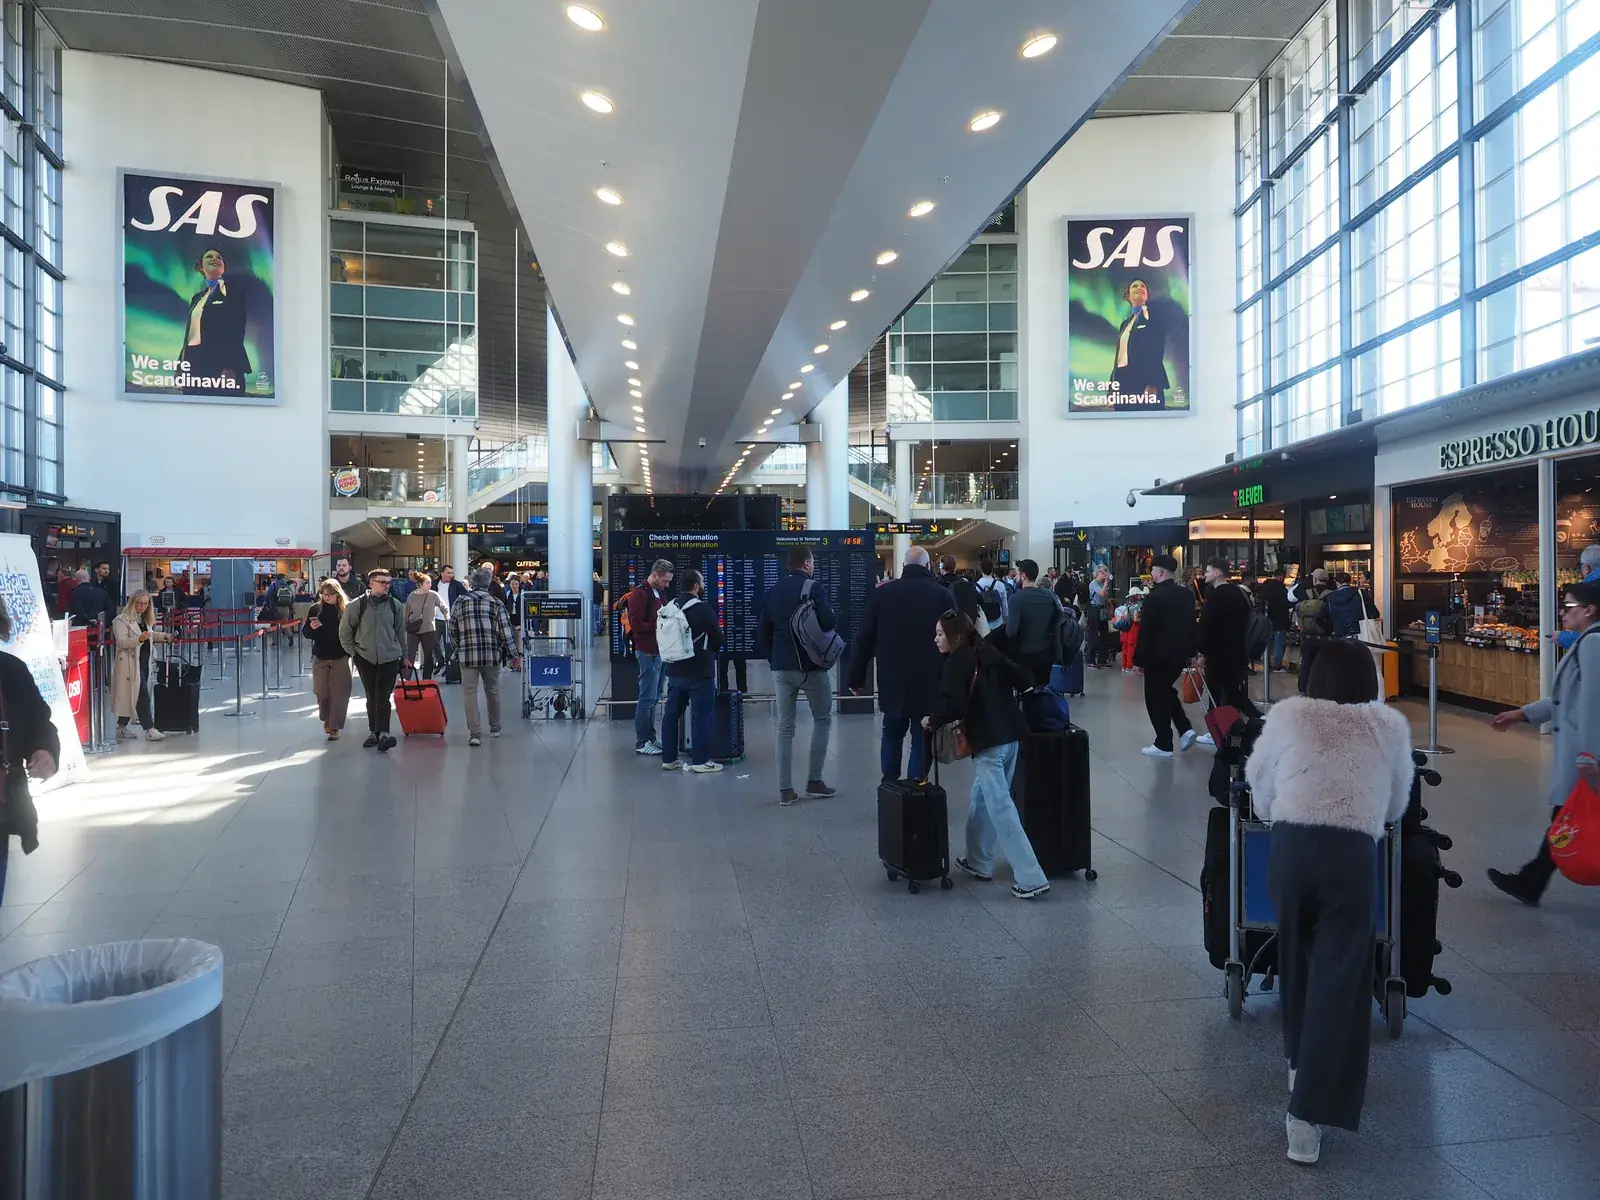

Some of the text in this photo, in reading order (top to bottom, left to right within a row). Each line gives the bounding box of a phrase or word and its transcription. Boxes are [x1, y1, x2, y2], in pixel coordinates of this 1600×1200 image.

[345, 174, 400, 186] Regus Express
[130, 185, 269, 238] SAS
[1072, 225, 1184, 269] SAS
[131, 354, 191, 372] We are
[131, 372, 241, 390] Scandinavia.
[1073, 379, 1120, 391] We are
[1073, 391, 1161, 406] Scandinavia.
[1438, 424, 1537, 470] ESPRESSO
[338, 479, 358, 489] KING
[481, 523, 486, 533] 1
[901, 524, 905, 532] 1
[649, 533, 679, 541] Check-in
[822, 537, 829, 546] 3
[515, 560, 541, 568] CAFFEINE
[541, 667, 560, 675] SAS
[68, 680, 81, 698] DSB
